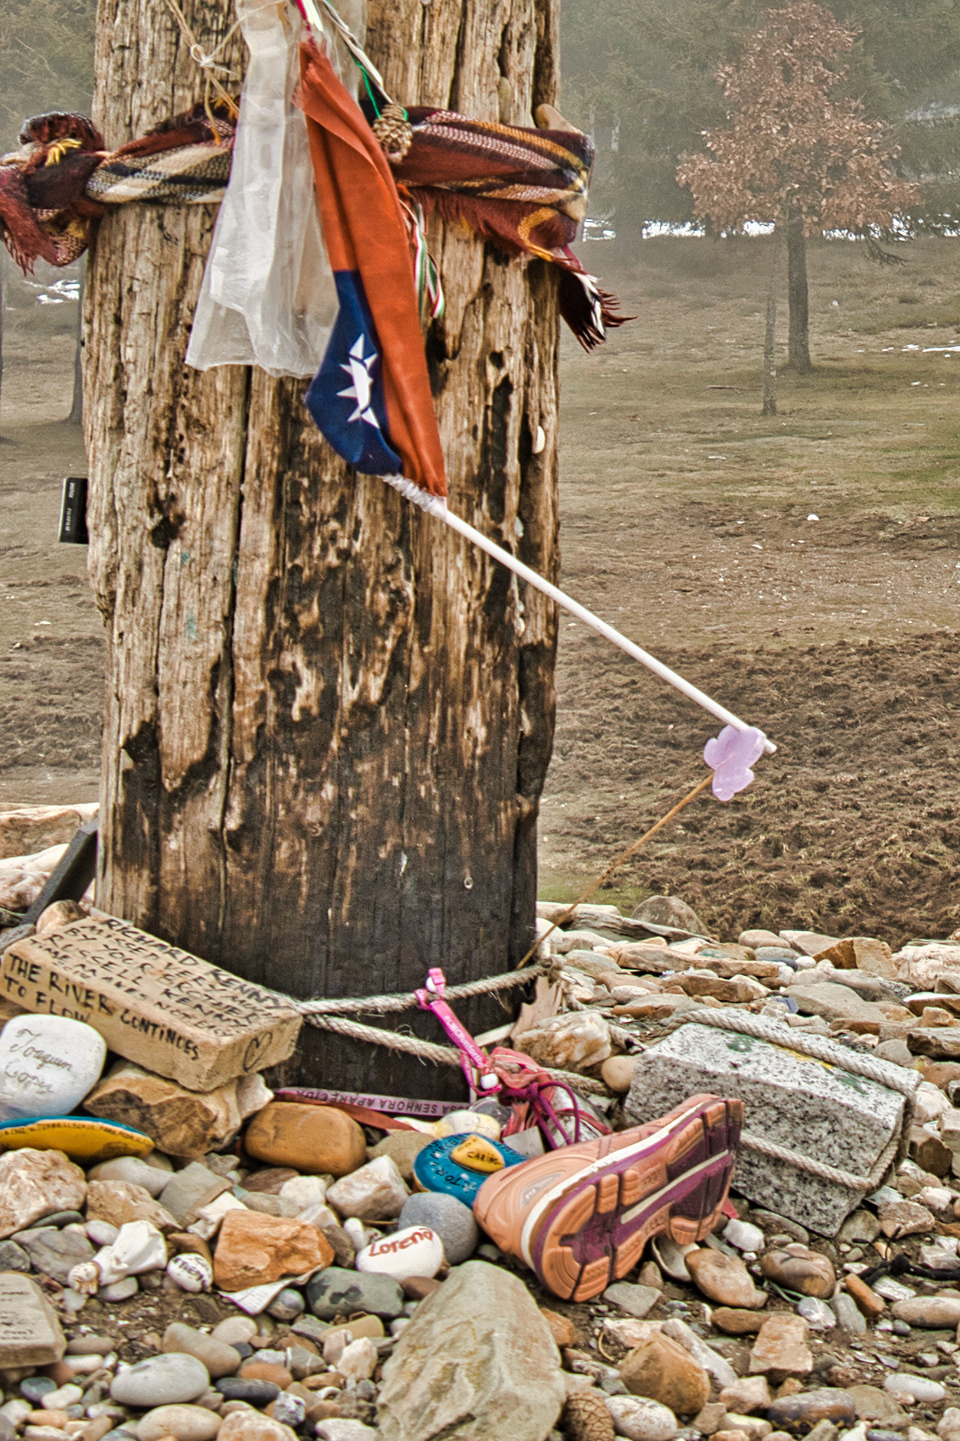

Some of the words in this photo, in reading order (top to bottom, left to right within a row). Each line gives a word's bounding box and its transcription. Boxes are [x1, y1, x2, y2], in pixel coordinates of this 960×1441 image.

[65, 507, 73, 532] FUJIFILM
[64, 927, 97, 941] BY
[96, 943, 155, 974] YOUR
[4, 974, 27, 998] TO
[35, 990, 91, 1022] FLOW
[8, 952, 41, 983] THE
[49, 968, 113, 1015] RIVER
[380, 1099, 438, 1115] SENHORA
